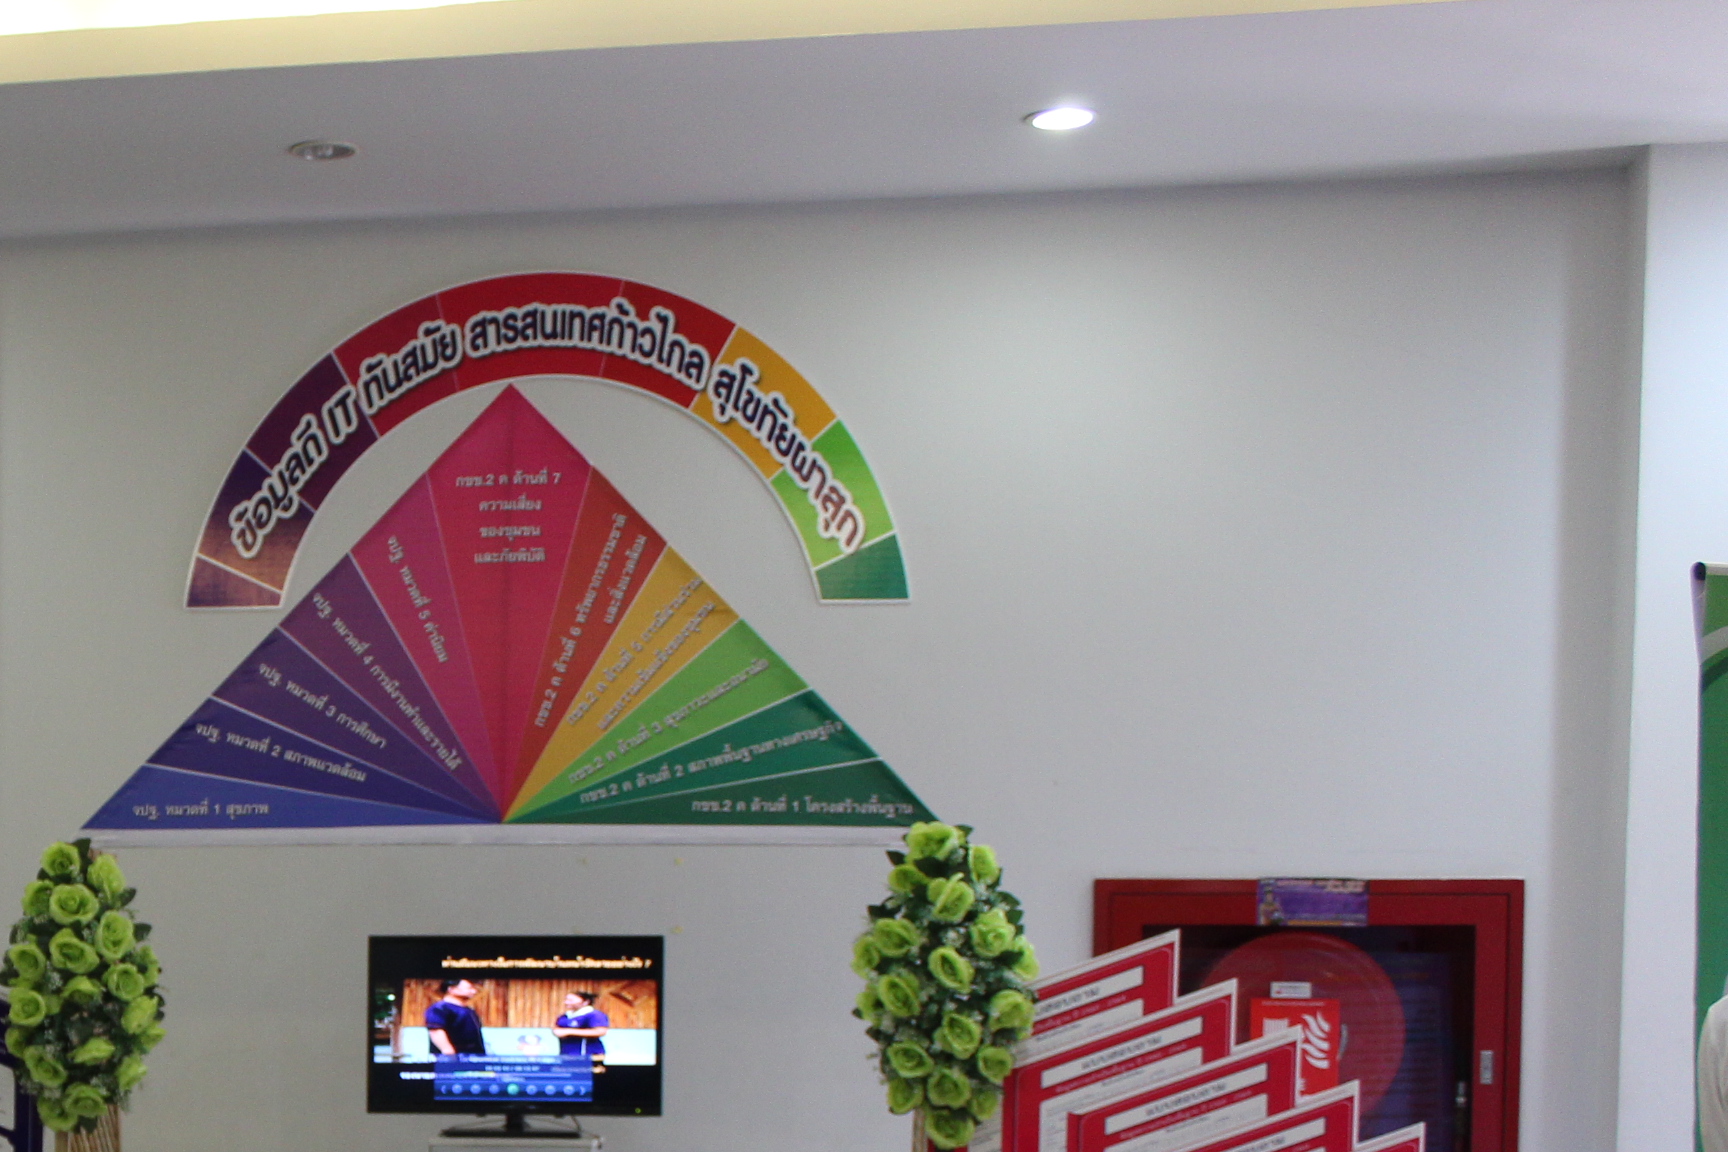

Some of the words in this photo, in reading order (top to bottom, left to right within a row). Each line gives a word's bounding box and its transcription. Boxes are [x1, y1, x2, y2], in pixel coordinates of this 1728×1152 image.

[325, 389, 357, 439] IT
[363, 324, 457, 409] ทันสมัย
[472, 300, 706, 384] สารสนเทศก้าวไกล
[713, 363, 859, 548] สุโขทัยผาสุก
[513, 466, 548, 485] ด้านที่
[552, 472, 561, 484] 7
[479, 493, 542, 511] ความเสี่ยง
[479, 526, 542, 541] ของชุมชน
[474, 547, 546, 564] และภัยพิบัติ
[399, 565, 432, 608] หมวดที่
[604, 533, 648, 625] และสิ่งแวดล้อม
[418, 610, 431, 621] 5
[569, 626, 582, 637] 6
[424, 621, 448, 664] ค่านิยม
[332, 617, 371, 656] หมวดที่
[363, 655, 374, 666] 4
[370, 664, 463, 772] การมีงานทำและรายได้
[285, 679, 327, 712] หมวดที่
[325, 705, 337, 718] 3
[336, 712, 388, 750] การศึกษา
[651, 721, 664, 734] 3
[226, 731, 269, 754] หมวดที่
[271, 745, 281, 757] 2
[283, 749, 367, 783] สภาพแวดล้อม
[674, 764, 685, 778] 2
[165, 797, 209, 816] หมวดที่
[226, 803, 269, 820] สุขภาพ
